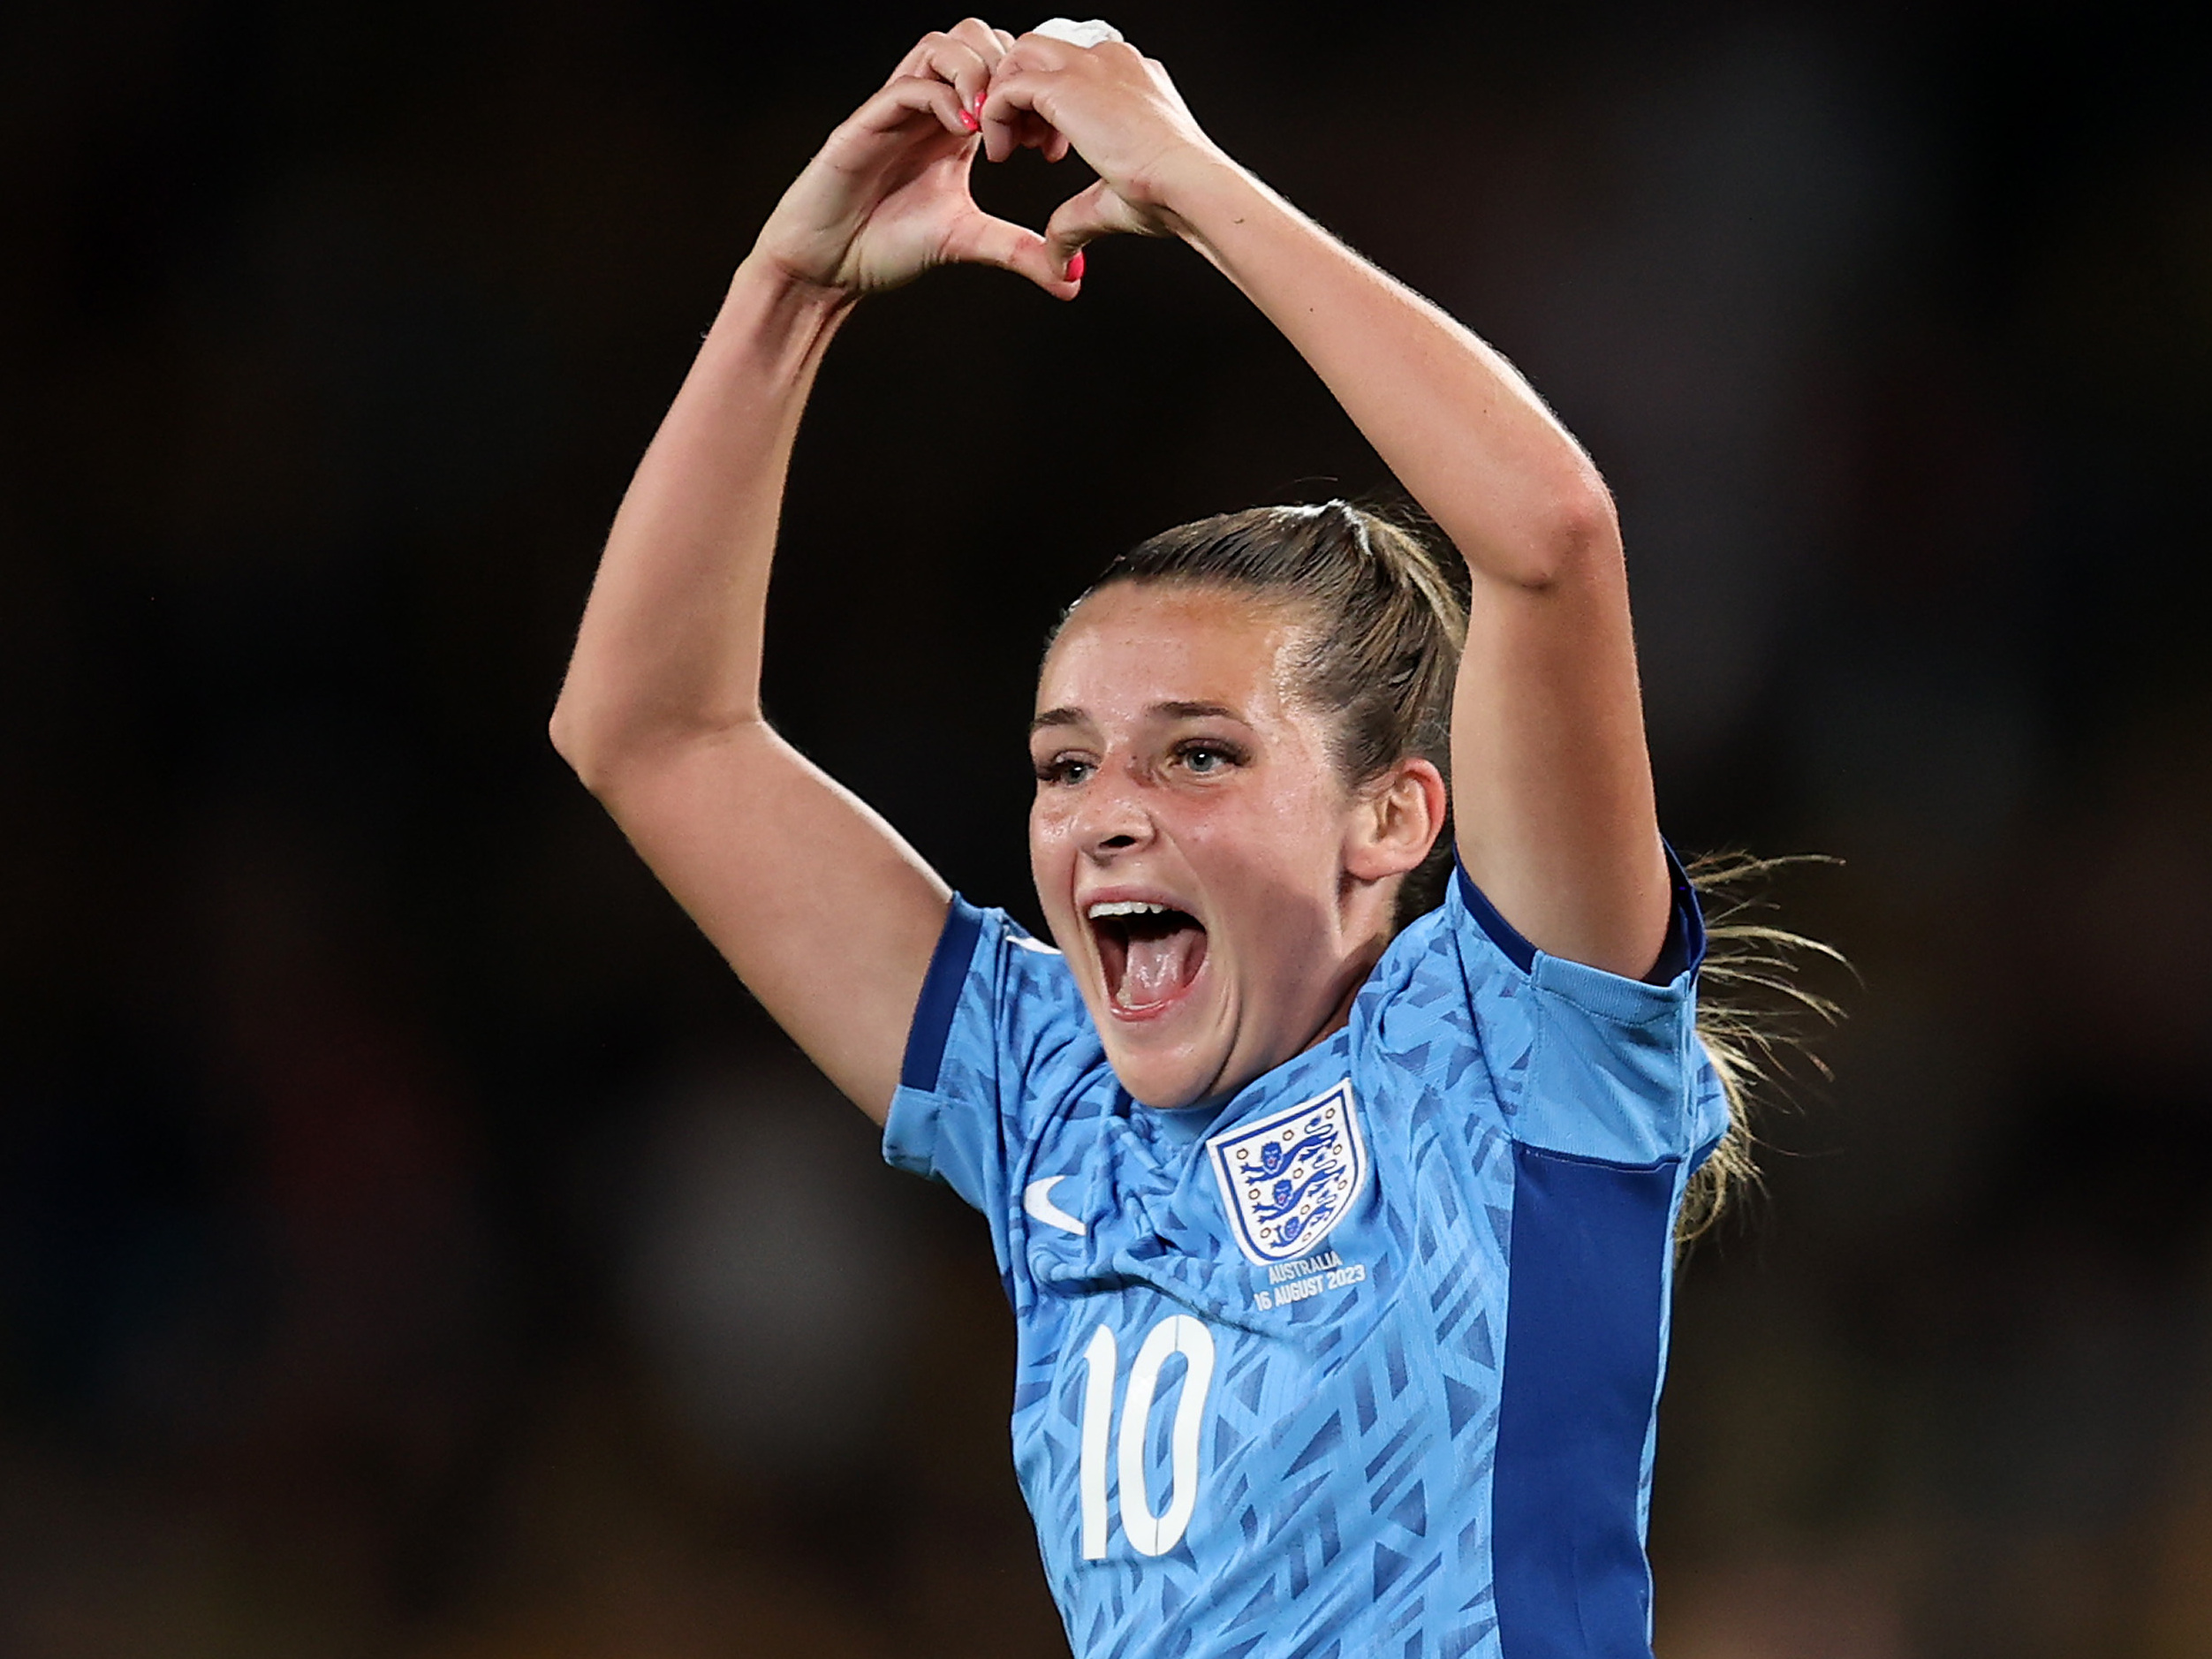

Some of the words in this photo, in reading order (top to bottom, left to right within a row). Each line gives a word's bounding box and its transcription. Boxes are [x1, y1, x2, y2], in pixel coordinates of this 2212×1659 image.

[1254, 1292, 1272, 1311] 16
[1274, 1275, 1323, 1306] AUGUST
[1327, 1264, 1366, 1289] 2023
[1268, 1250, 1343, 1284] AUSTRALIA
[1080, 1314, 1216, 1560] 10
